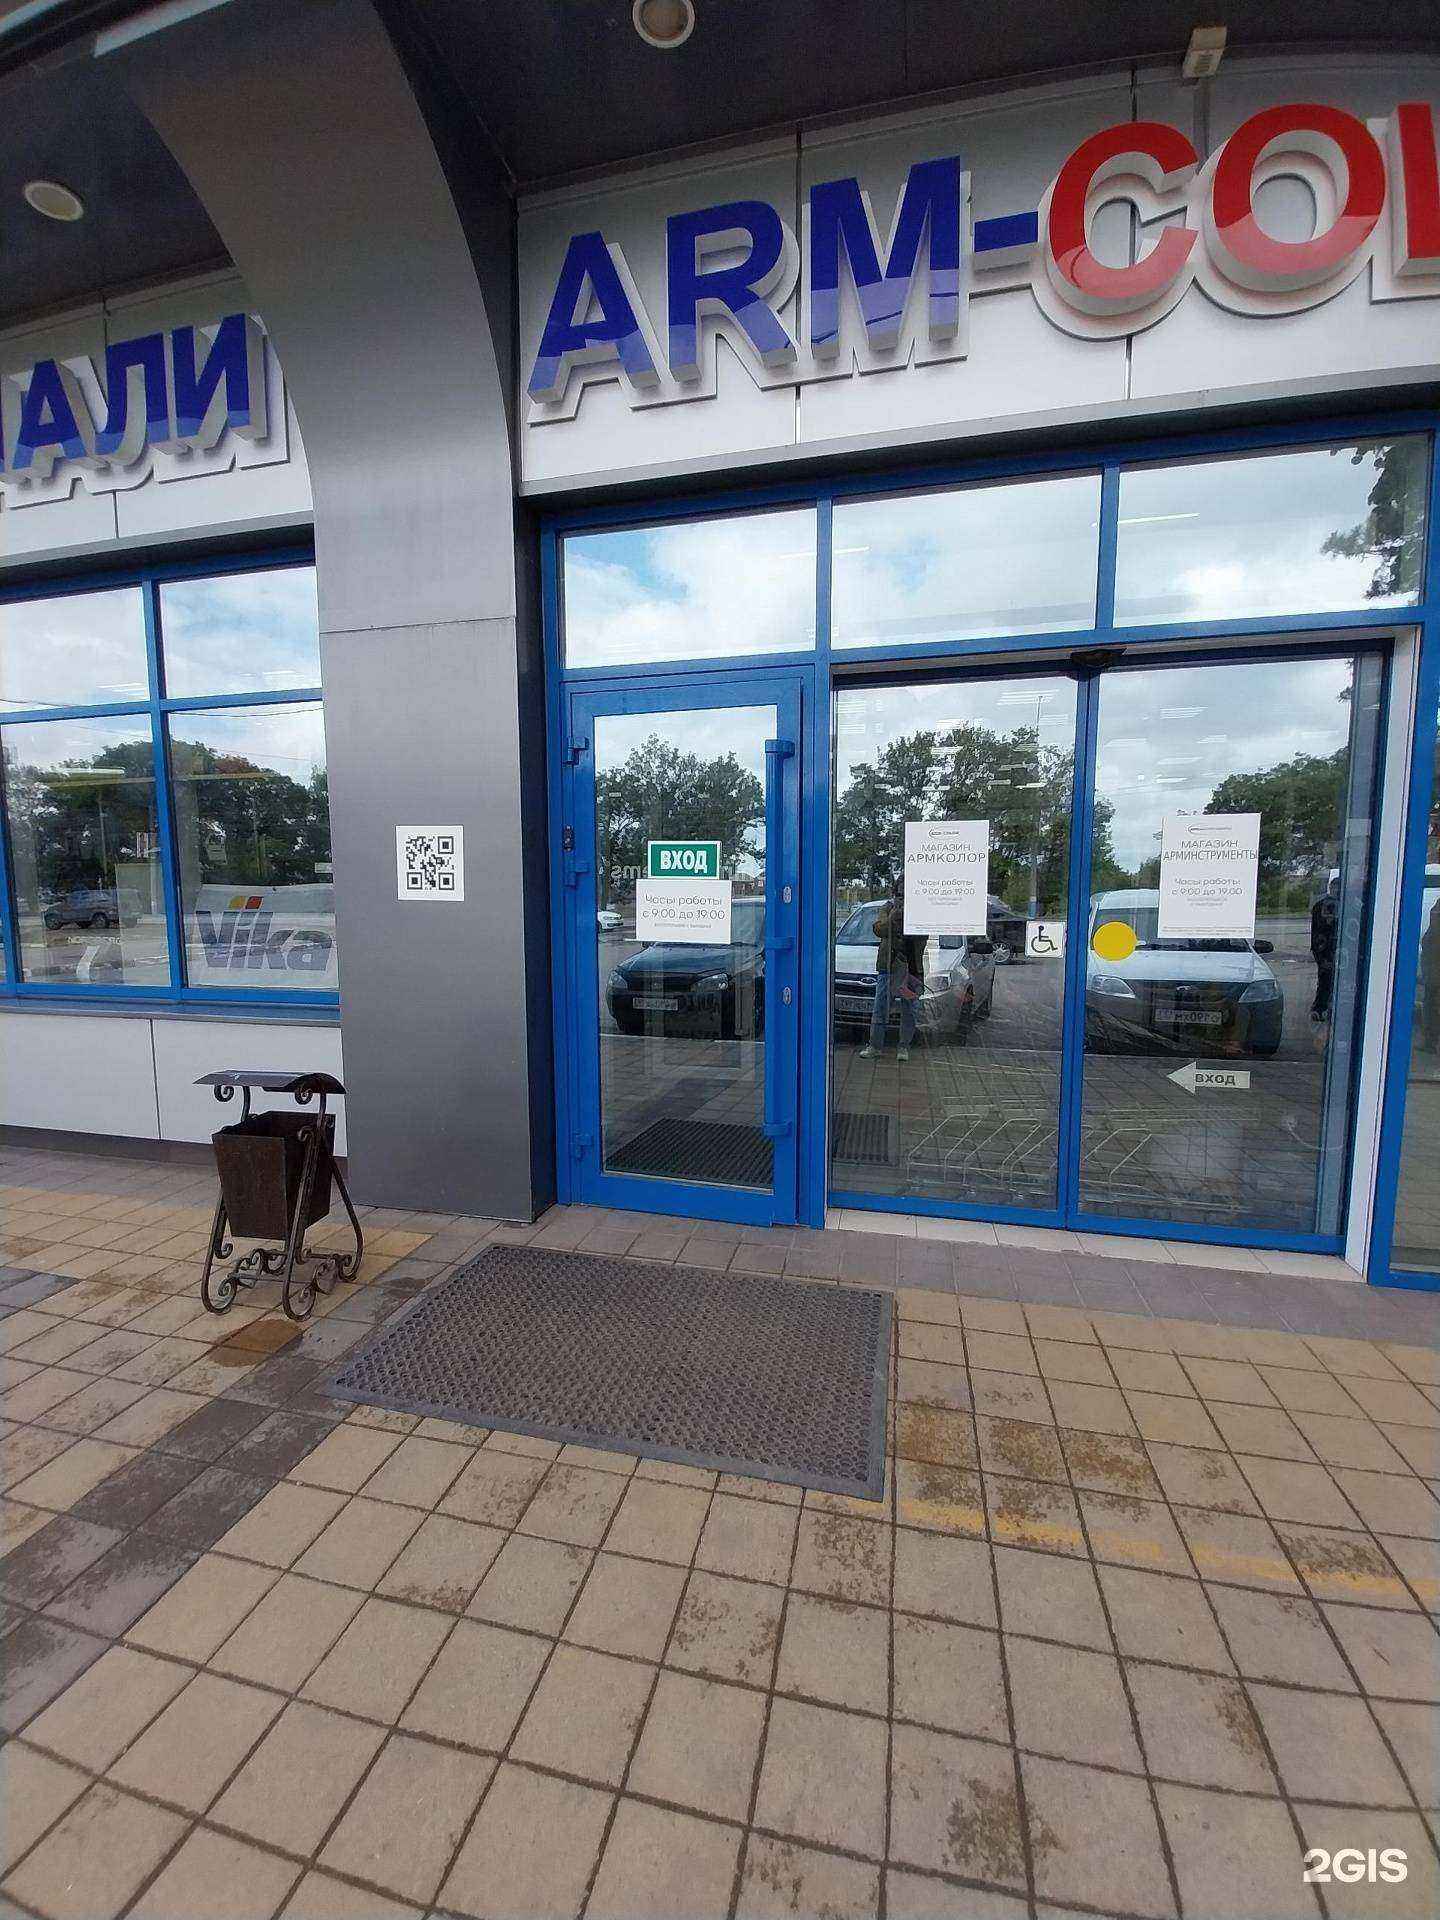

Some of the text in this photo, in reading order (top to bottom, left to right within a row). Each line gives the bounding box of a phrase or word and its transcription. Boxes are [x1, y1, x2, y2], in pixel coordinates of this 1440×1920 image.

[0, 313, 256, 475] АЛИ
[922, 843, 971, 852] МАГАЗИН
[1181, 839, 1238, 849] МАГАЗИН
[907, 852, 986, 864] АРМКОЛОР
[1163, 849, 1258, 861] АРМИНСТРУМЕНТЫ
[660, 850, 708, 874] ВХОД
[916, 877, 974, 888] Часы работы
[1174, 877, 1242, 887] Часы работы
[940, 888, 953, 897] до
[1202, 888, 1216, 897] до
[645, 894, 723, 907] Часы работы
[642, 910, 650, 919] с
[678, 910, 695, 921] до
[1195, 1073, 1236, 1086] ВХОД
